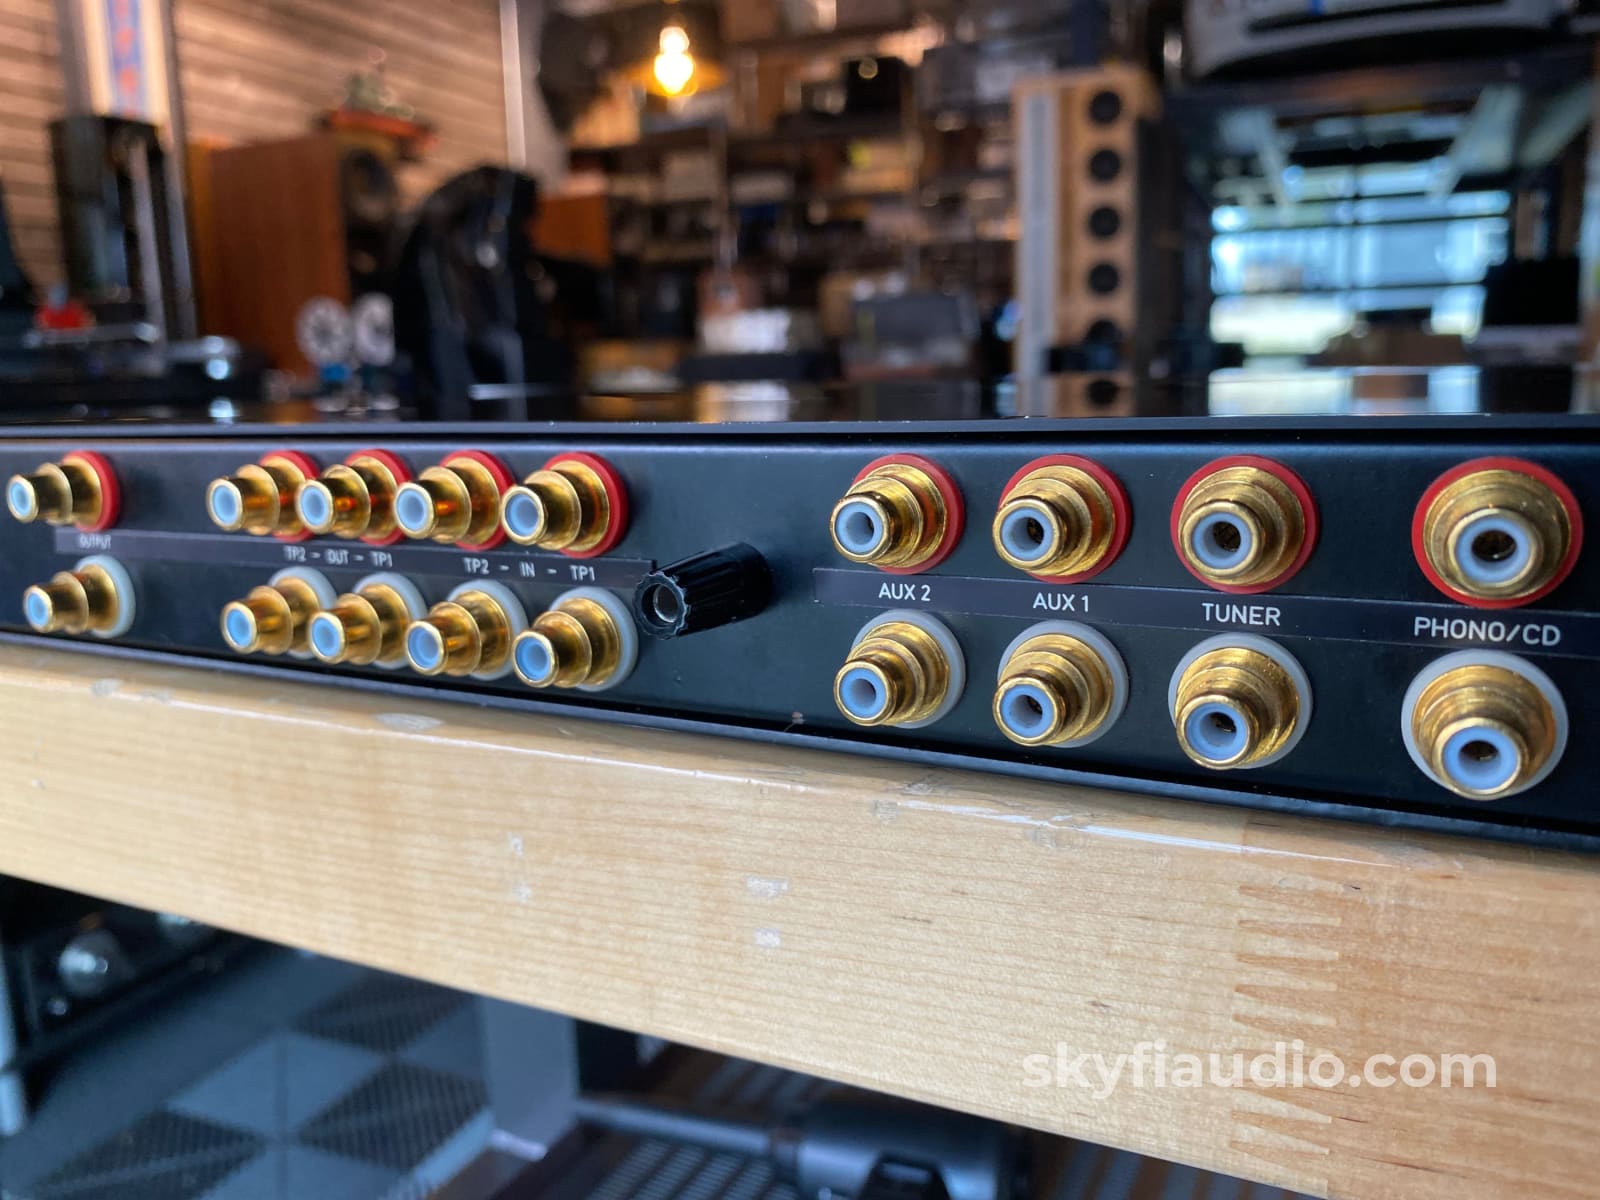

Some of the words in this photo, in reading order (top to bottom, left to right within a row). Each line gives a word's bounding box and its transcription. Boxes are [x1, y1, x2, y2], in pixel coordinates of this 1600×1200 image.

[283, 544, 307, 562] TP2
[325, 548, 349, 565] OUT
[369, 551, 393, 568] TP1
[462, 557, 490, 575] TP2
[519, 561, 536, 577] IN
[569, 564, 596, 582] TP1
[878, 582, 916, 601] AUX
[920, 584, 931, 602] 2
[1032, 592, 1076, 612] AUX
[1080, 595, 1090, 613] 1
[1202, 603, 1281, 626] TUNER
[1413, 616, 1562, 647] PHONO/CD
